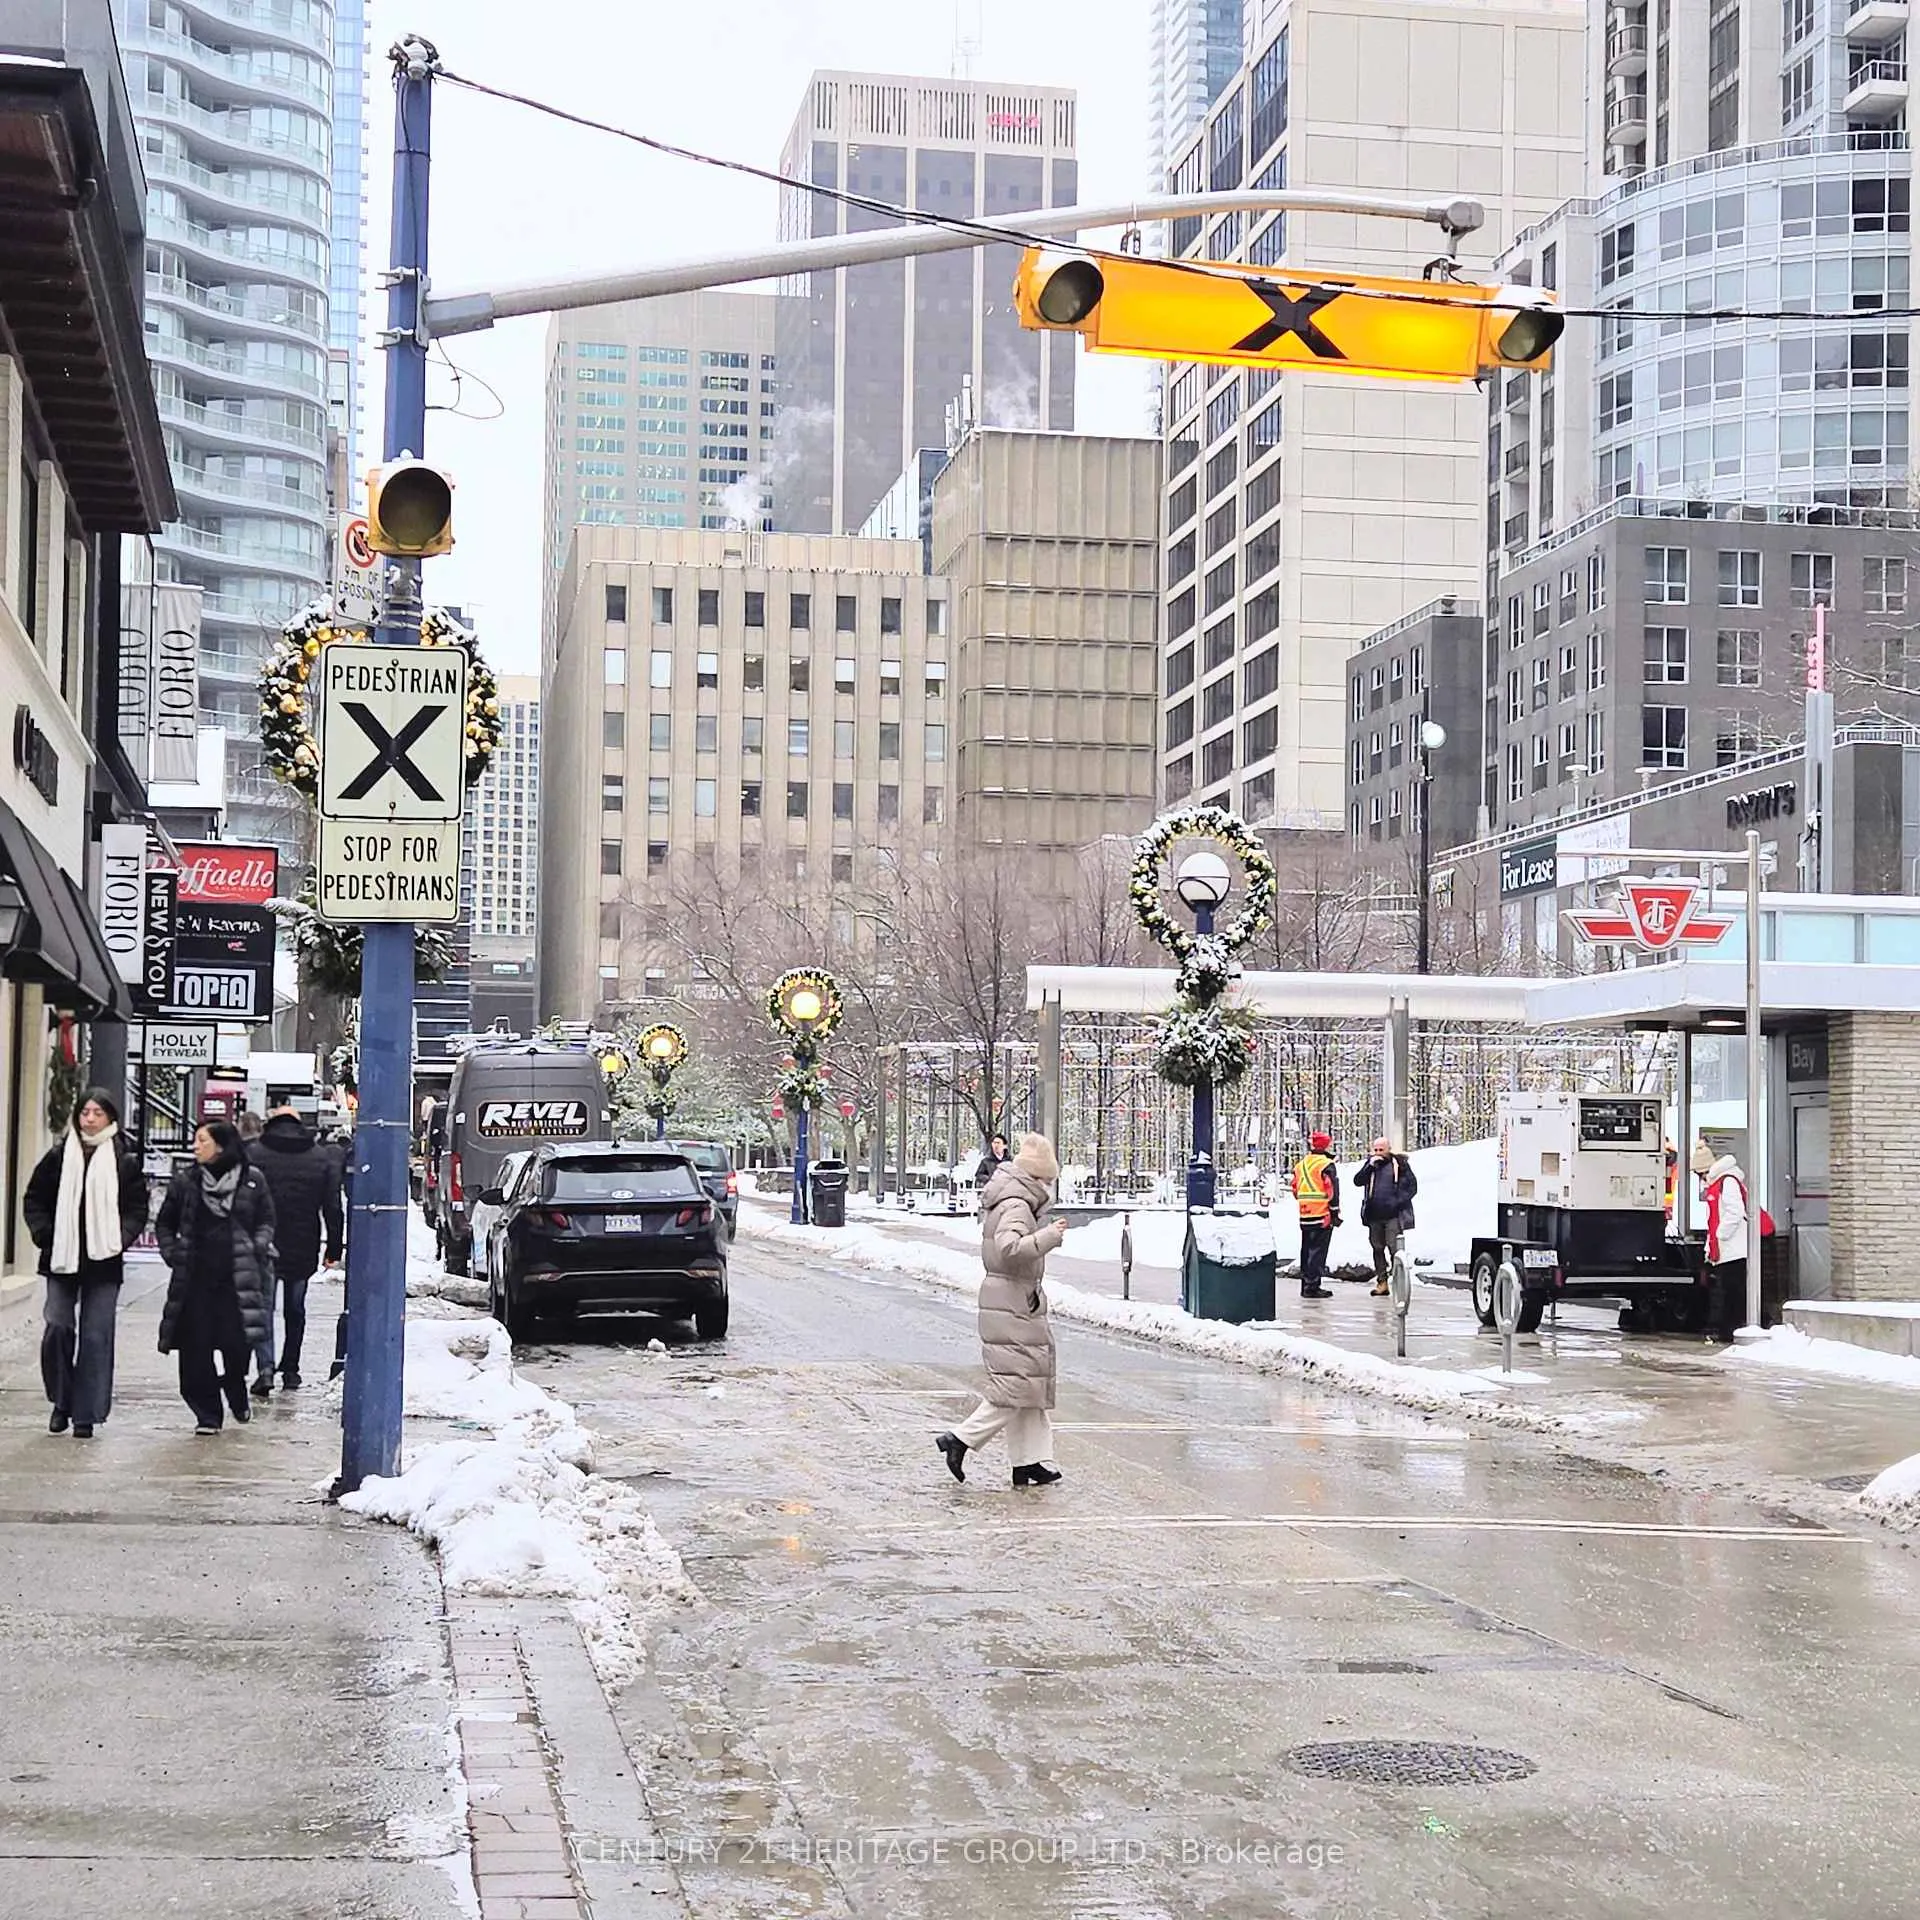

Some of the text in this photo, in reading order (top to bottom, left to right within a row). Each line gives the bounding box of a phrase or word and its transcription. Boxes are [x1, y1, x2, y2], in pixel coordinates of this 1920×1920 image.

[158, 629, 195, 739] FIORIO
[332, 664, 457, 694] PEDESTRIAN
[343, 836, 437, 863] STOP FOR
[323, 874, 455, 901] PEDESTRIANS
[1502, 857, 1554, 892] For Lease
[104, 854, 140, 954] FIORIO
[147, 878, 170, 998] NEW YOU
[152, 1033, 208, 1047] HOLLY
[152, 1047, 208, 1058] EYEWEAR
[1791, 1043, 1816, 1074] Bay
[481, 1102, 586, 1127] REVEL
